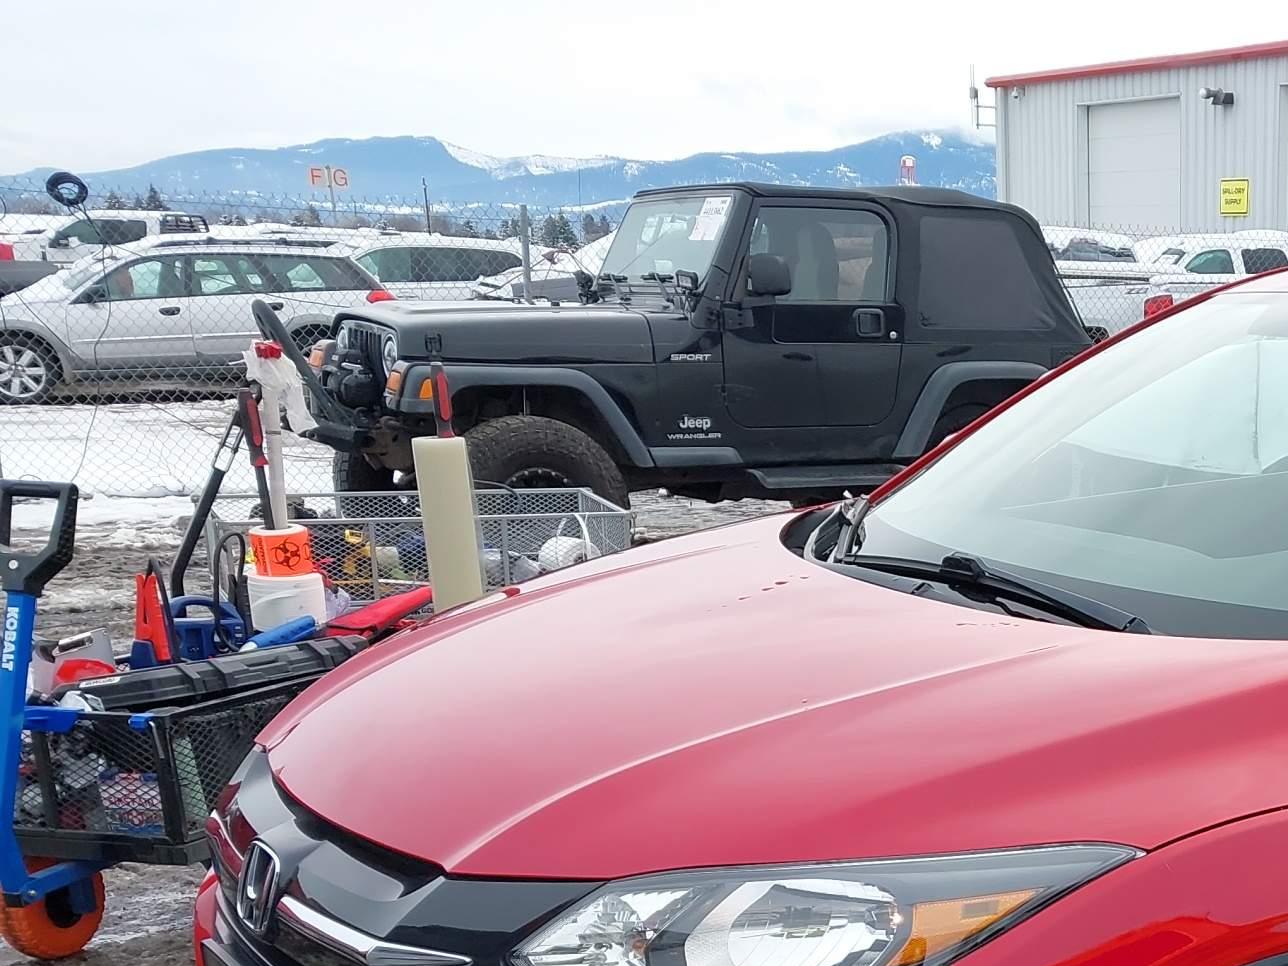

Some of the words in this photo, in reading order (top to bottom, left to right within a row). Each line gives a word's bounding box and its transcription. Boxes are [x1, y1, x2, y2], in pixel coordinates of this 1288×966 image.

[310, 167, 321, 185] F
[333, 169, 348, 187] G
[670, 353, 712, 361] SPORT
[679, 416, 711, 430] Jeep
[1, 606, 20, 672] KOBALT
